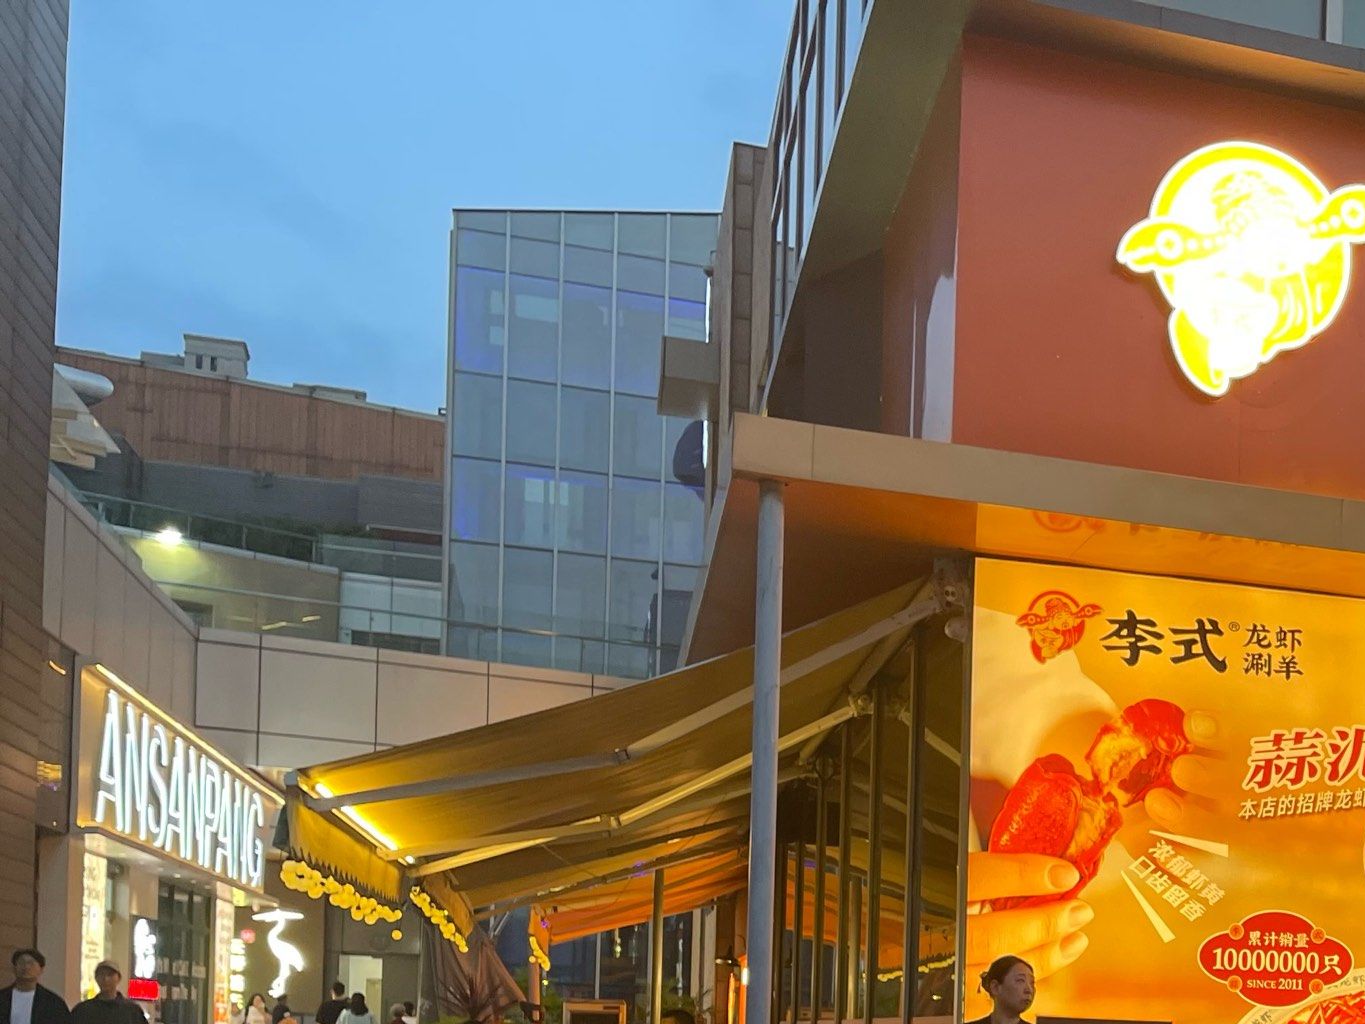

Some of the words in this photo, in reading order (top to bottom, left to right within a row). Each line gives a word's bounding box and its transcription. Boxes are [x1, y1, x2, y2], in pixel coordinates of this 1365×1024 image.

[1244, 623, 1304, 653] 龙虾
[1243, 652, 1304, 681] 涮羊
[94, 688, 264, 887] ANSANPANG
[1128, 855, 1207, 922] 口齿留香
[1248, 930, 1310, 949] 累计销量
[1246, 979, 1277, 990] SINCE
[1278, 978, 1304, 991] 2011
